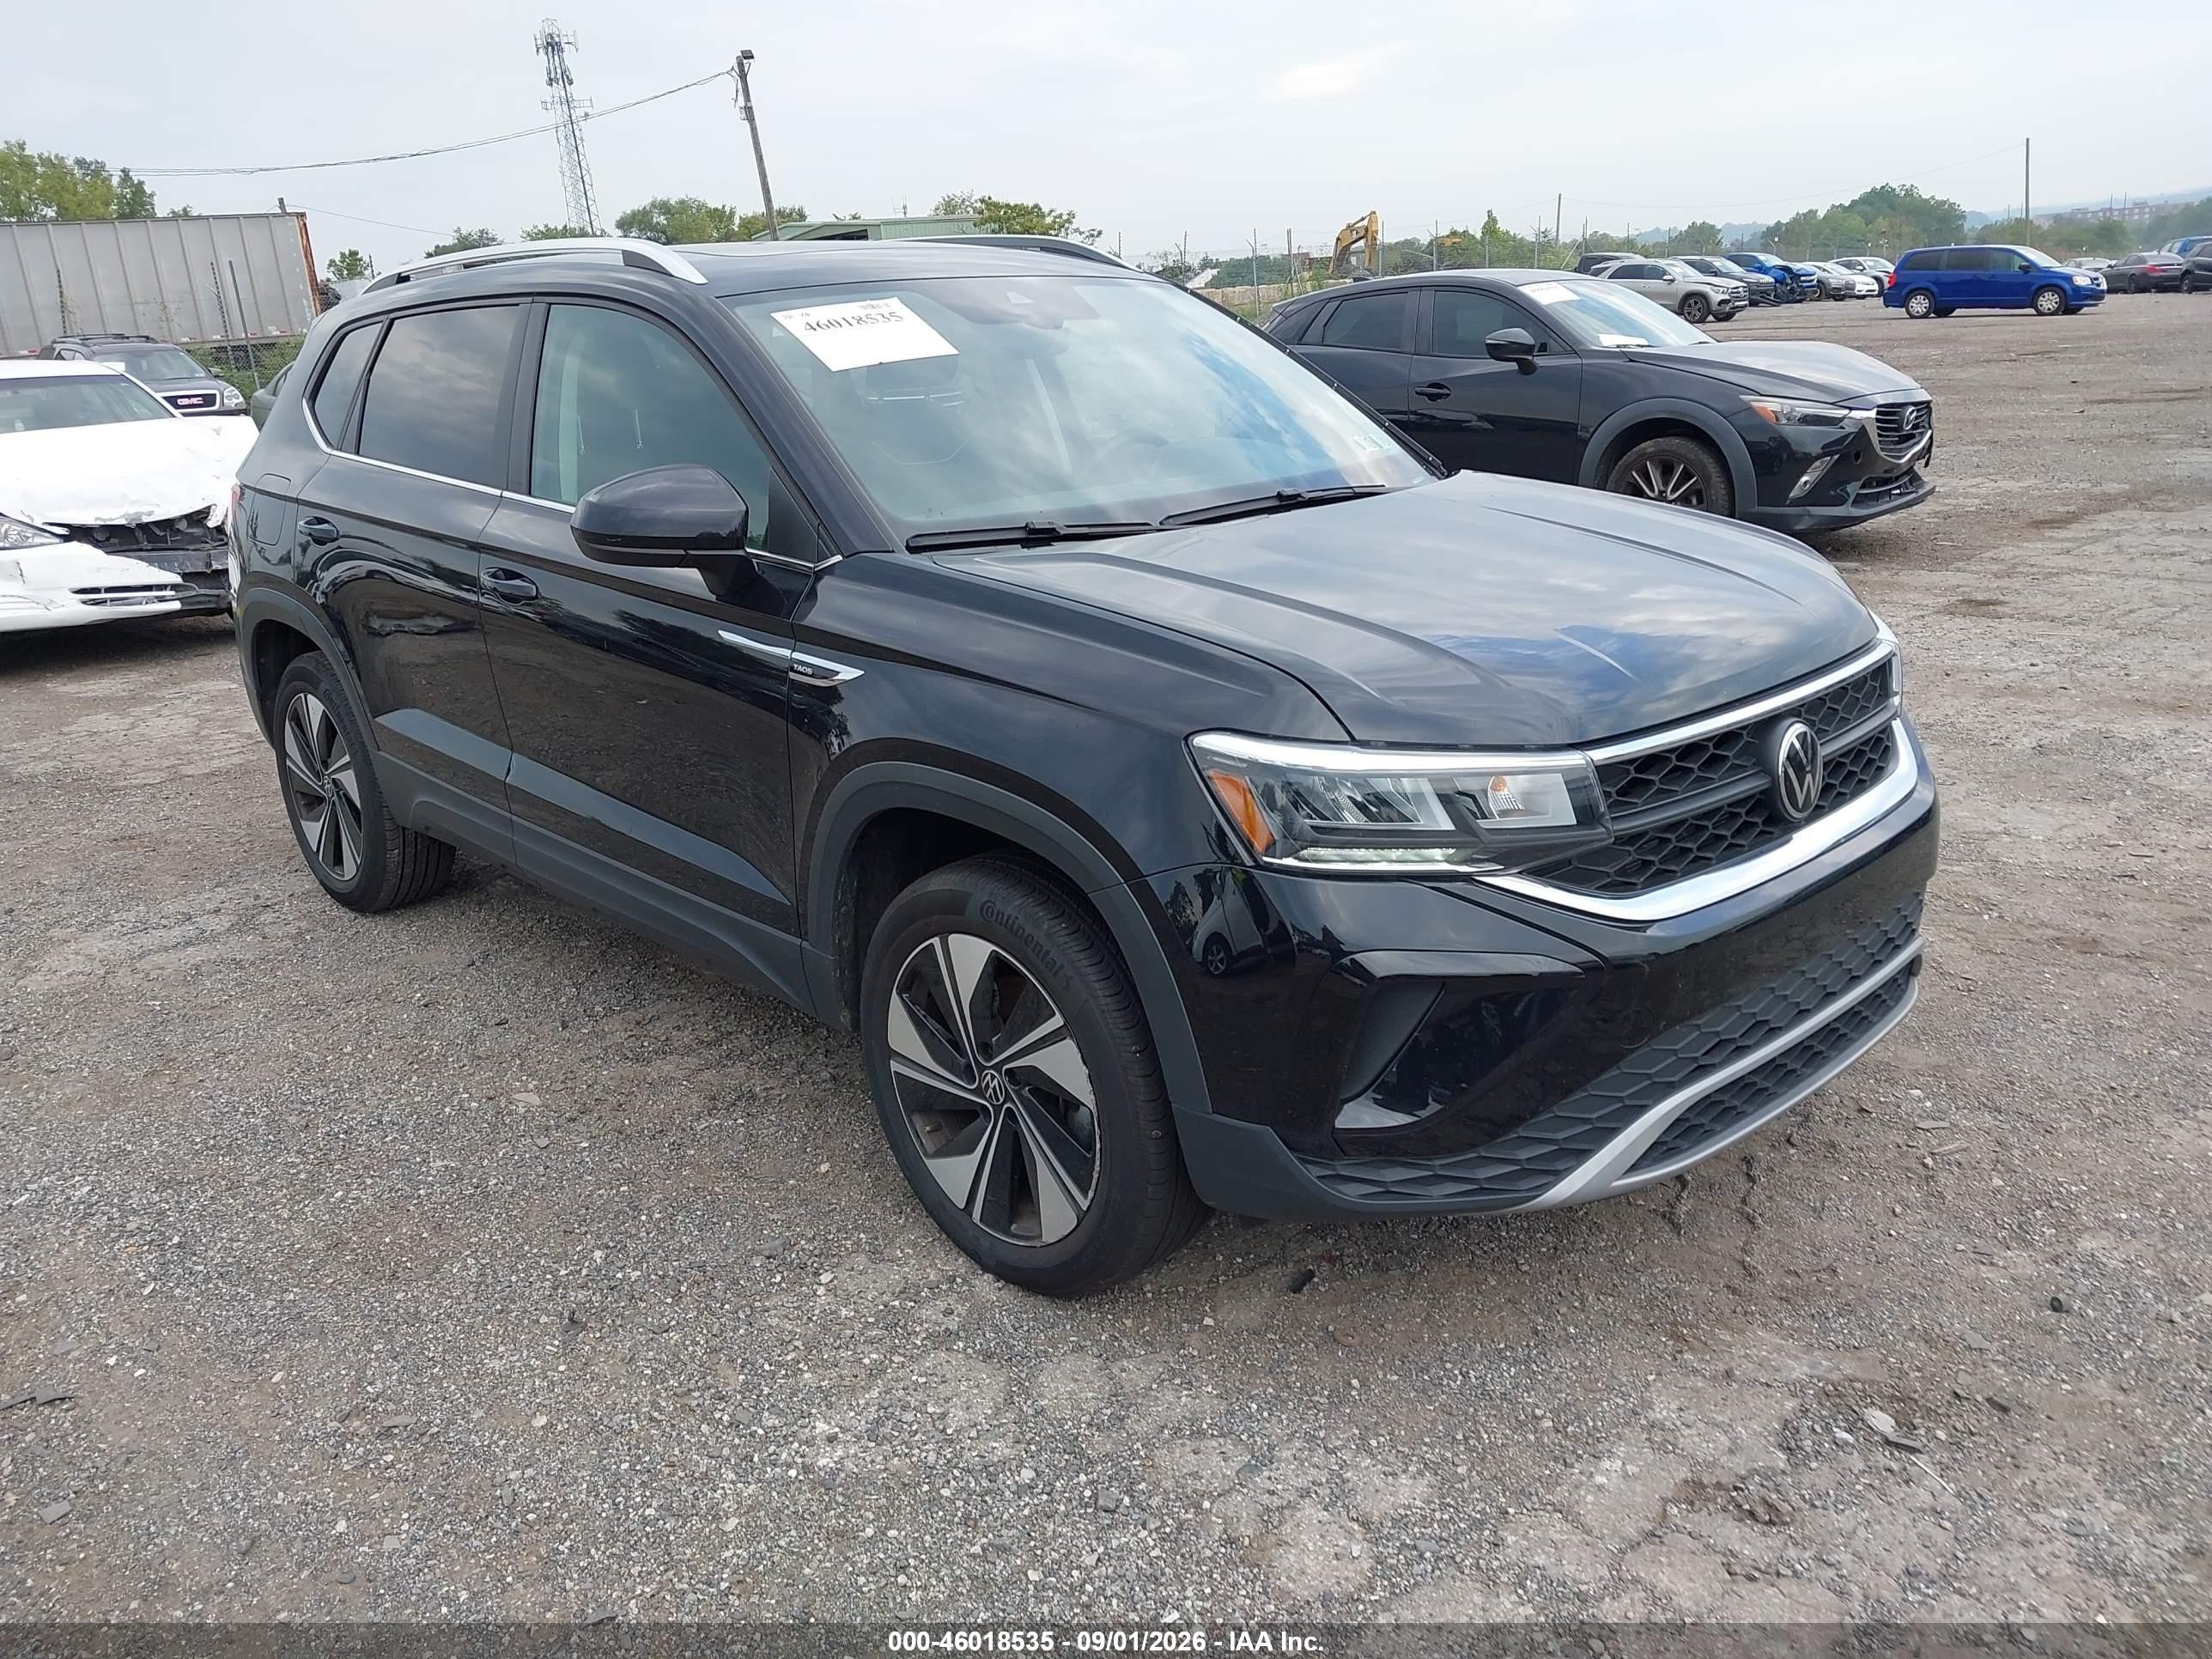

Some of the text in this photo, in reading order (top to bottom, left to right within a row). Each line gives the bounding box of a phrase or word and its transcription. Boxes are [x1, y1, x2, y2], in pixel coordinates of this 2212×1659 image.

[805, 311, 903, 331] 46018535
[177, 397, 204, 405] GMC
[793, 663, 813, 675] TAOS
[979, 899, 1066, 975] Continental
